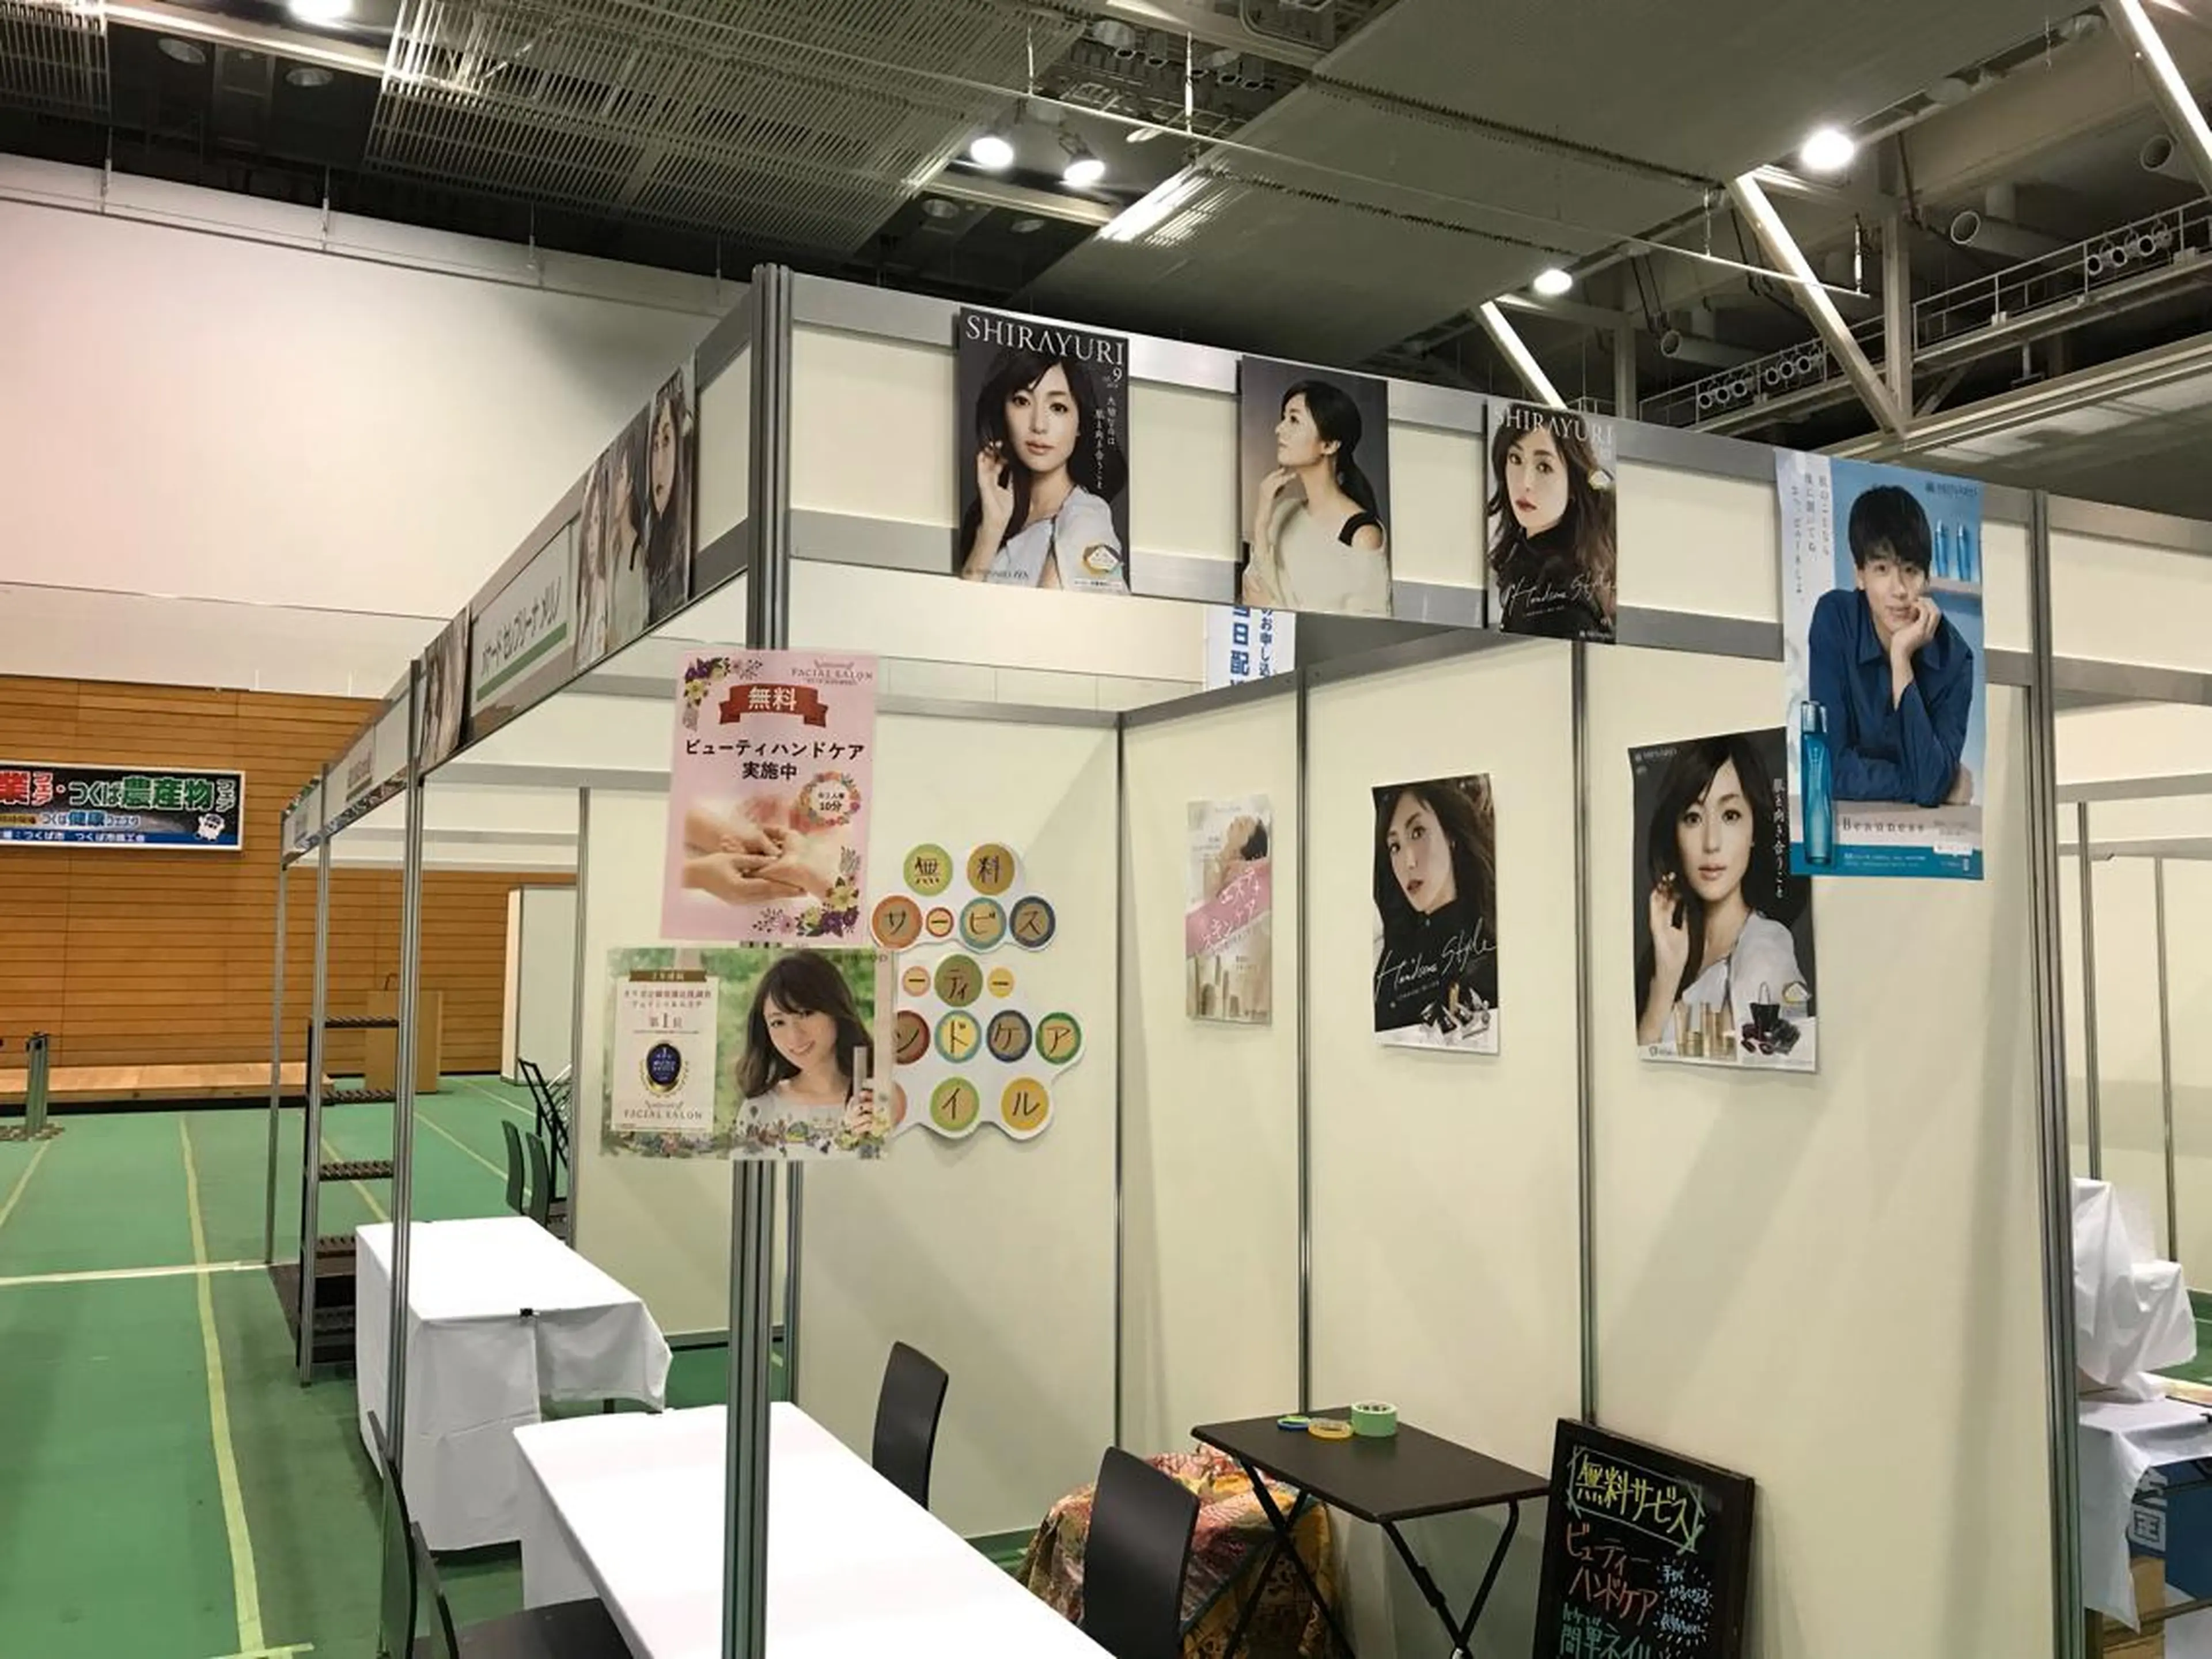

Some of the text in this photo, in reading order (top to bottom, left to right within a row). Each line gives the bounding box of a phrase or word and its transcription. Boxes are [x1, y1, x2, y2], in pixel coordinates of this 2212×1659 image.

[966, 315, 1123, 366] SHIRAYURI
[1112, 368, 1122, 382] 9
[1496, 406, 1612, 445] SHIRAYURI
[1230, 607, 1251, 685] 日配
[791, 668, 873, 681] FACIAL SALON
[748, 687, 797, 711] 無料
[685, 738, 865, 761] ビューティハンドケア
[742, 761, 798, 781] 実施中
[820, 800, 842, 812] 10分
[914, 855, 999, 885] 無料
[884, 908, 1041, 936] サービス
[1440, 916, 1498, 975] Style
[624, 1109, 661, 1119] FACIAL
